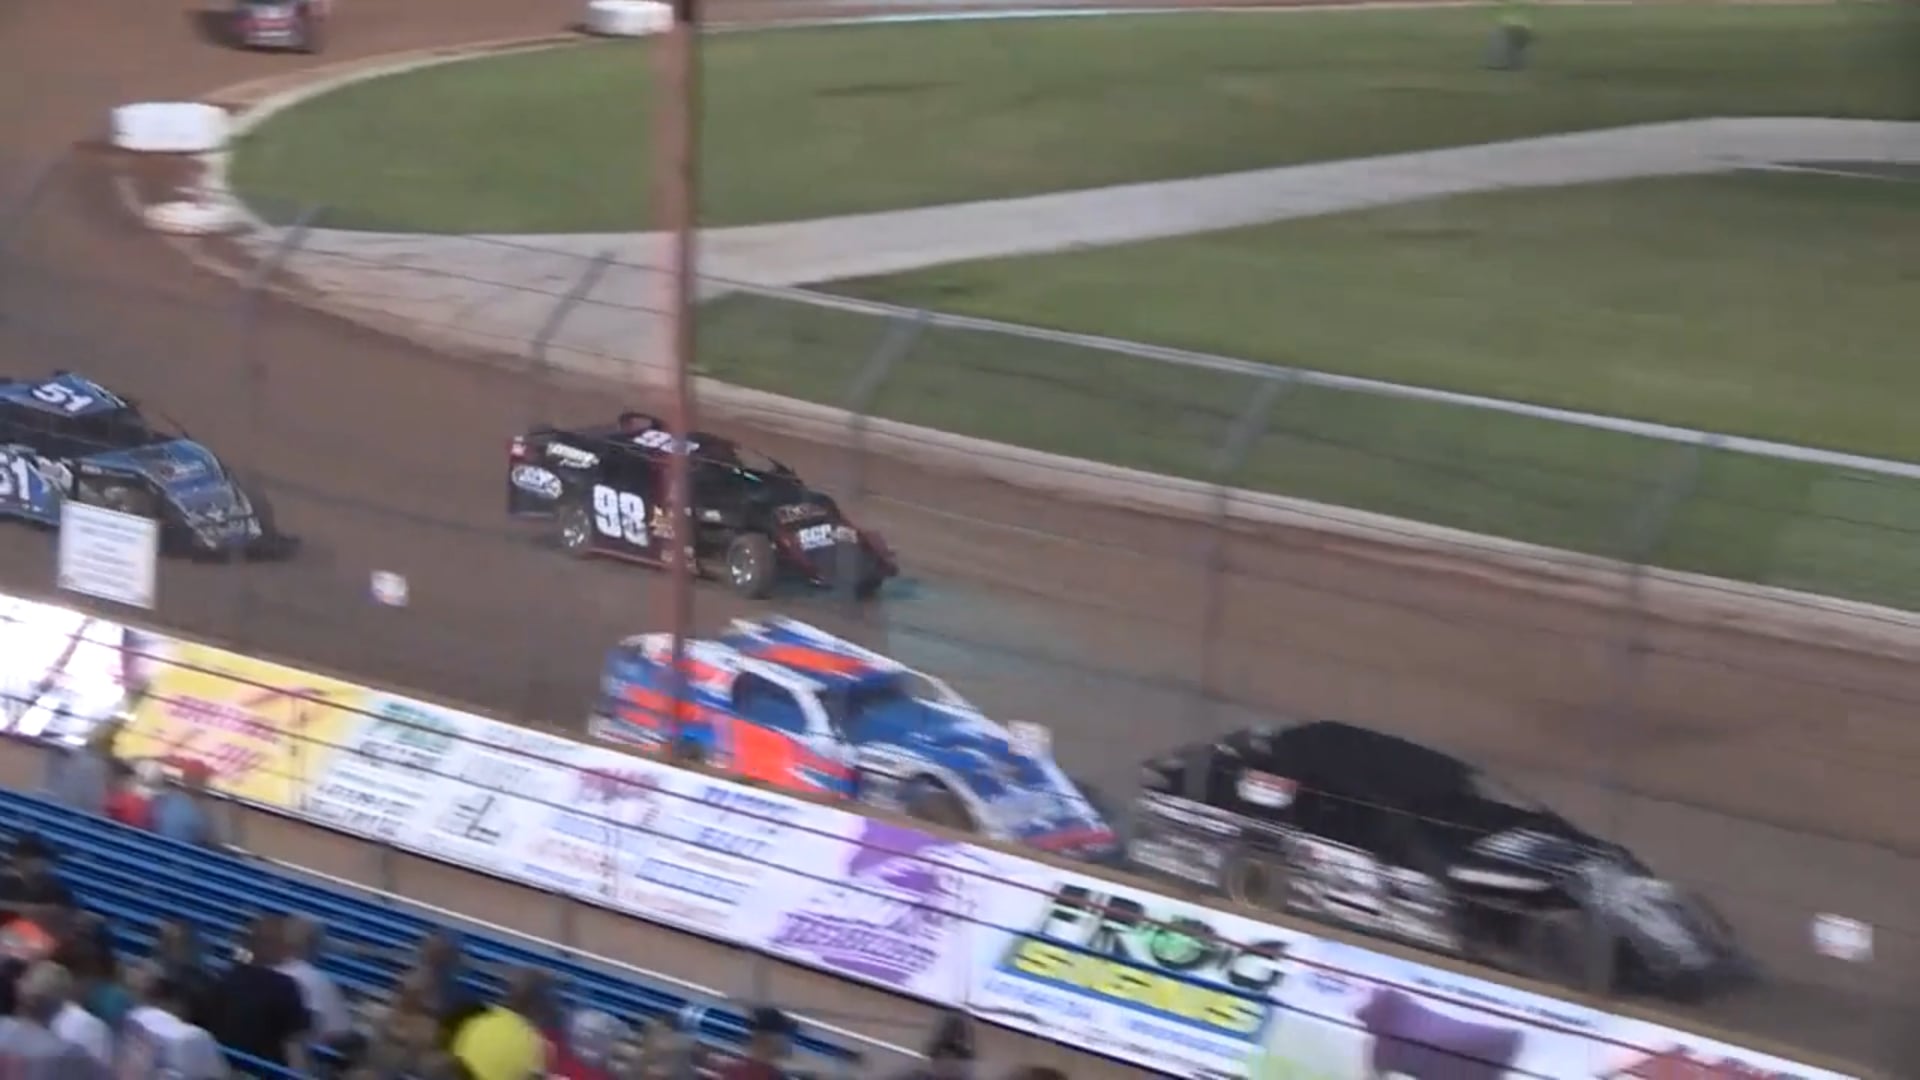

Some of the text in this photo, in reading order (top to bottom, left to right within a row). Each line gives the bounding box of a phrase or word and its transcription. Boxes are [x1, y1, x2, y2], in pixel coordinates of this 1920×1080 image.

[32, 382, 93, 412] 51
[593, 484, 649, 547] 98
[1040, 881, 1291, 988] FROG
